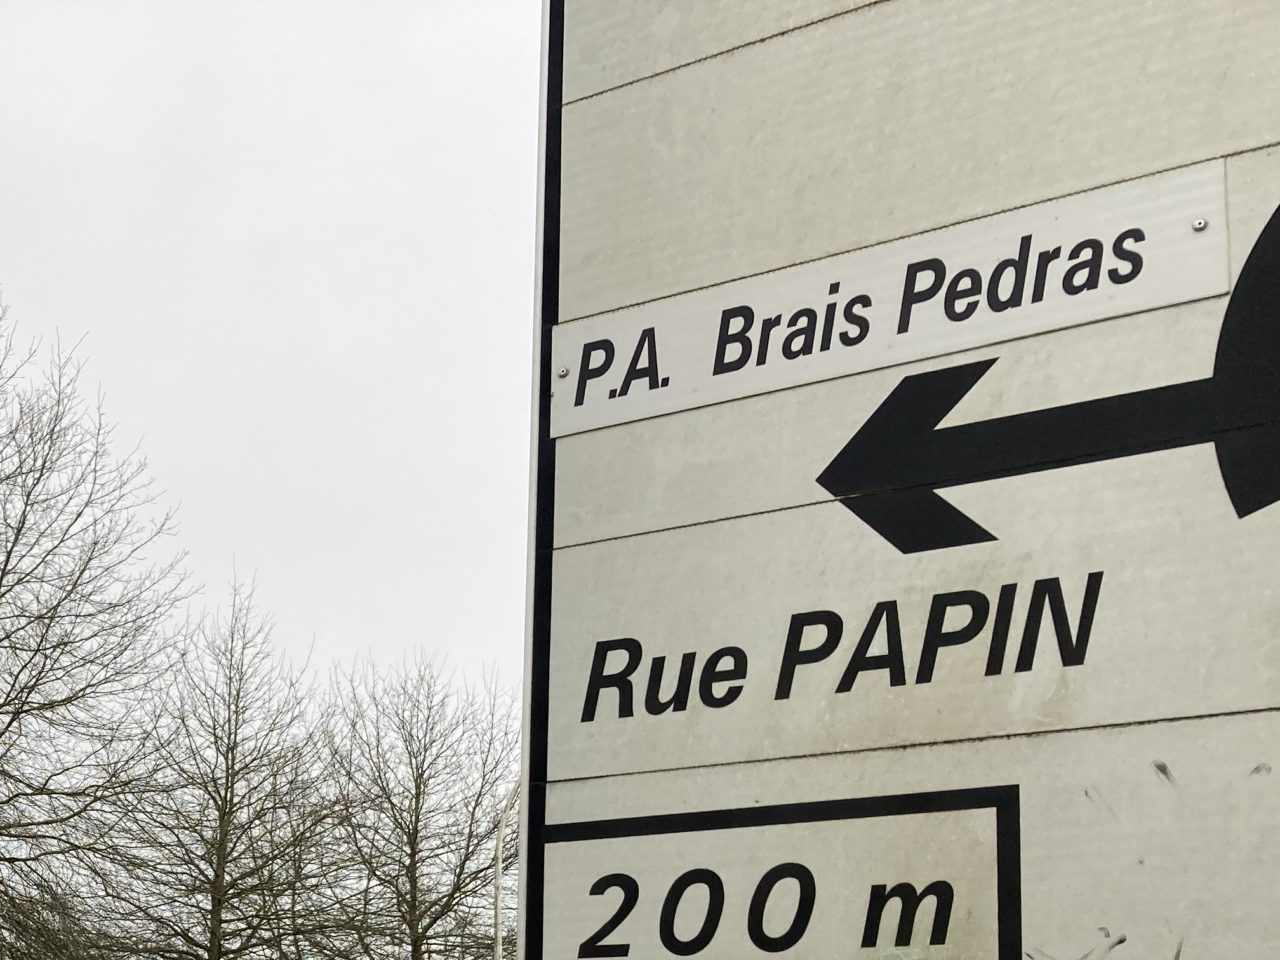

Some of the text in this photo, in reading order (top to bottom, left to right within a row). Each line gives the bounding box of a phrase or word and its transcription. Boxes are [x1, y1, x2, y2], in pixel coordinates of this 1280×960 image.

[574, 228, 1145, 407] P.A. Brais Pedras
[580, 570, 1104, 723] Rue PAPIN
[577, 862, 955, 959] 200 m
